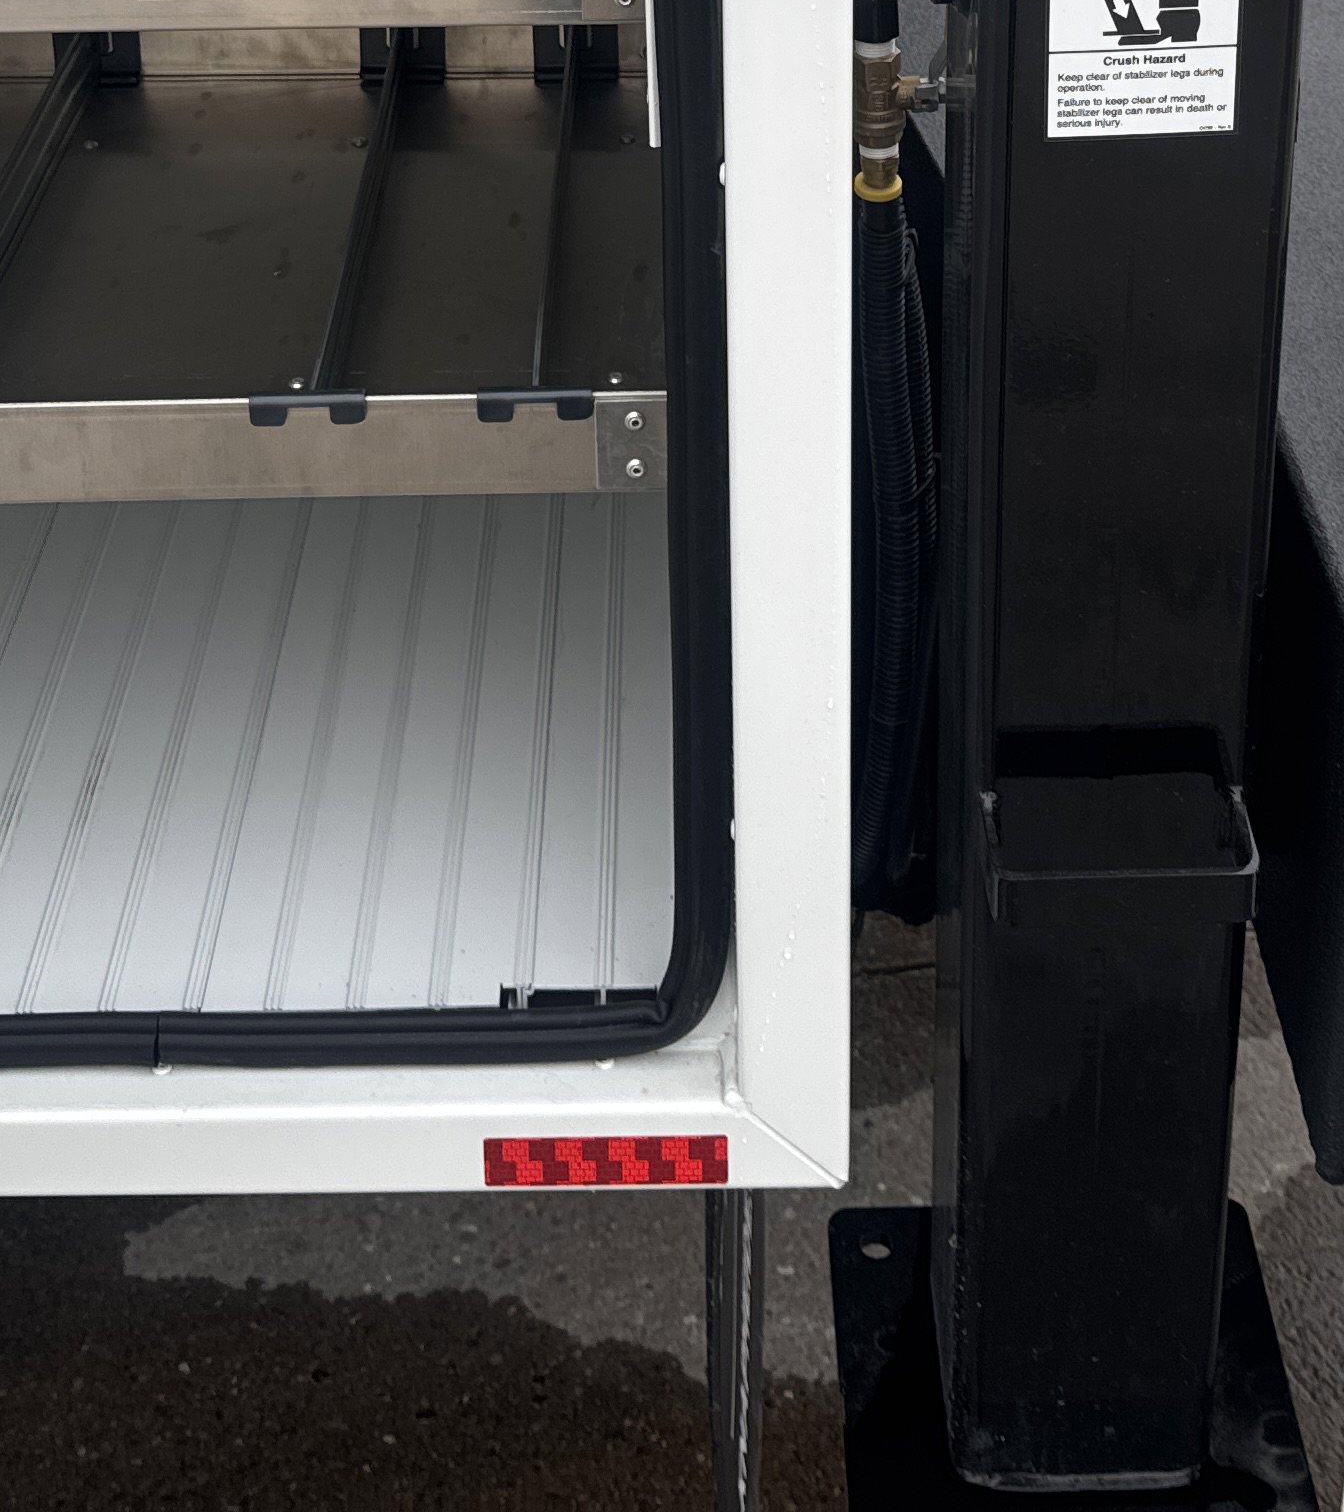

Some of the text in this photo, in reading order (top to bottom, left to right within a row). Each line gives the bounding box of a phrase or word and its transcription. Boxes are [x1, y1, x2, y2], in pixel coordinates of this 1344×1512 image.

[1103, 53, 1186, 66] Crush Hazard
[1057, 67, 1224, 83] Keep clear of stabilizer legs during
[1057, 83, 1105, 94] operation.
[1057, 94, 1205, 107] Failure to keep clear of moving
[1057, 108, 1100, 117] stabilizer
[1102, 108, 1123, 118] legs
[1146, 105, 1172, 114] result
[1175, 105, 1184, 113] in
[1186, 103, 1214, 112] death
[1056, 118, 1123, 128] serious injury.
